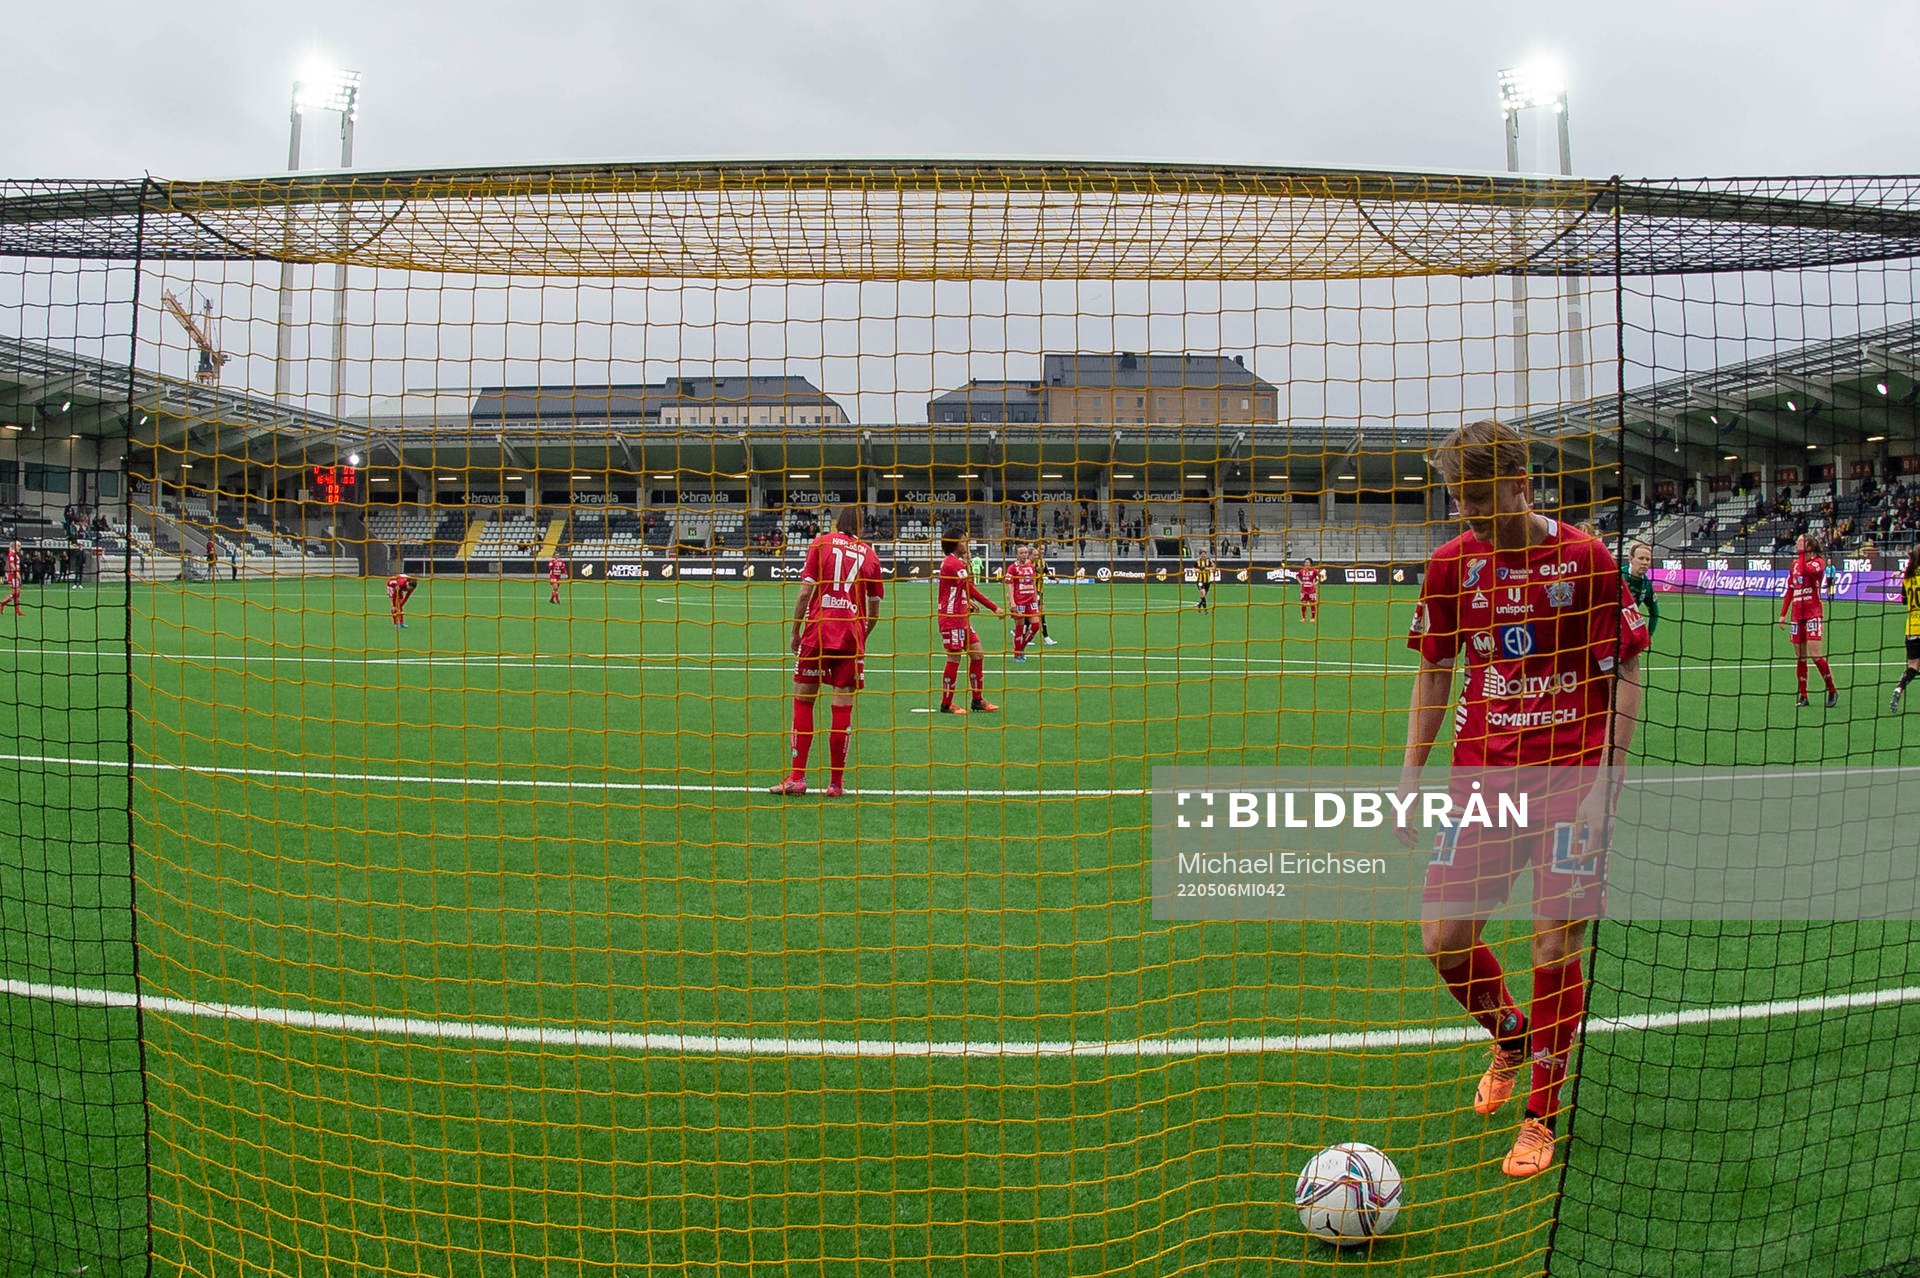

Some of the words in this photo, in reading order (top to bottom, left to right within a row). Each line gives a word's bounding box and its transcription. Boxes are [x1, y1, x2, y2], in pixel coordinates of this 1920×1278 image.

[580, 492, 619, 503] bravida
[689, 491, 729, 502] bravida
[800, 491, 841, 502] bravida
[915, 490, 956, 502] bravida
[1032, 491, 1072, 502] bravida
[832, 547, 865, 593] 17
[1697, 571, 1765, 596] Volkswagen
[1496, 604, 1535, 616] unisport
[1497, 671, 1577, 698] Botrygg
[1486, 708, 1577, 727] COMBITECH
